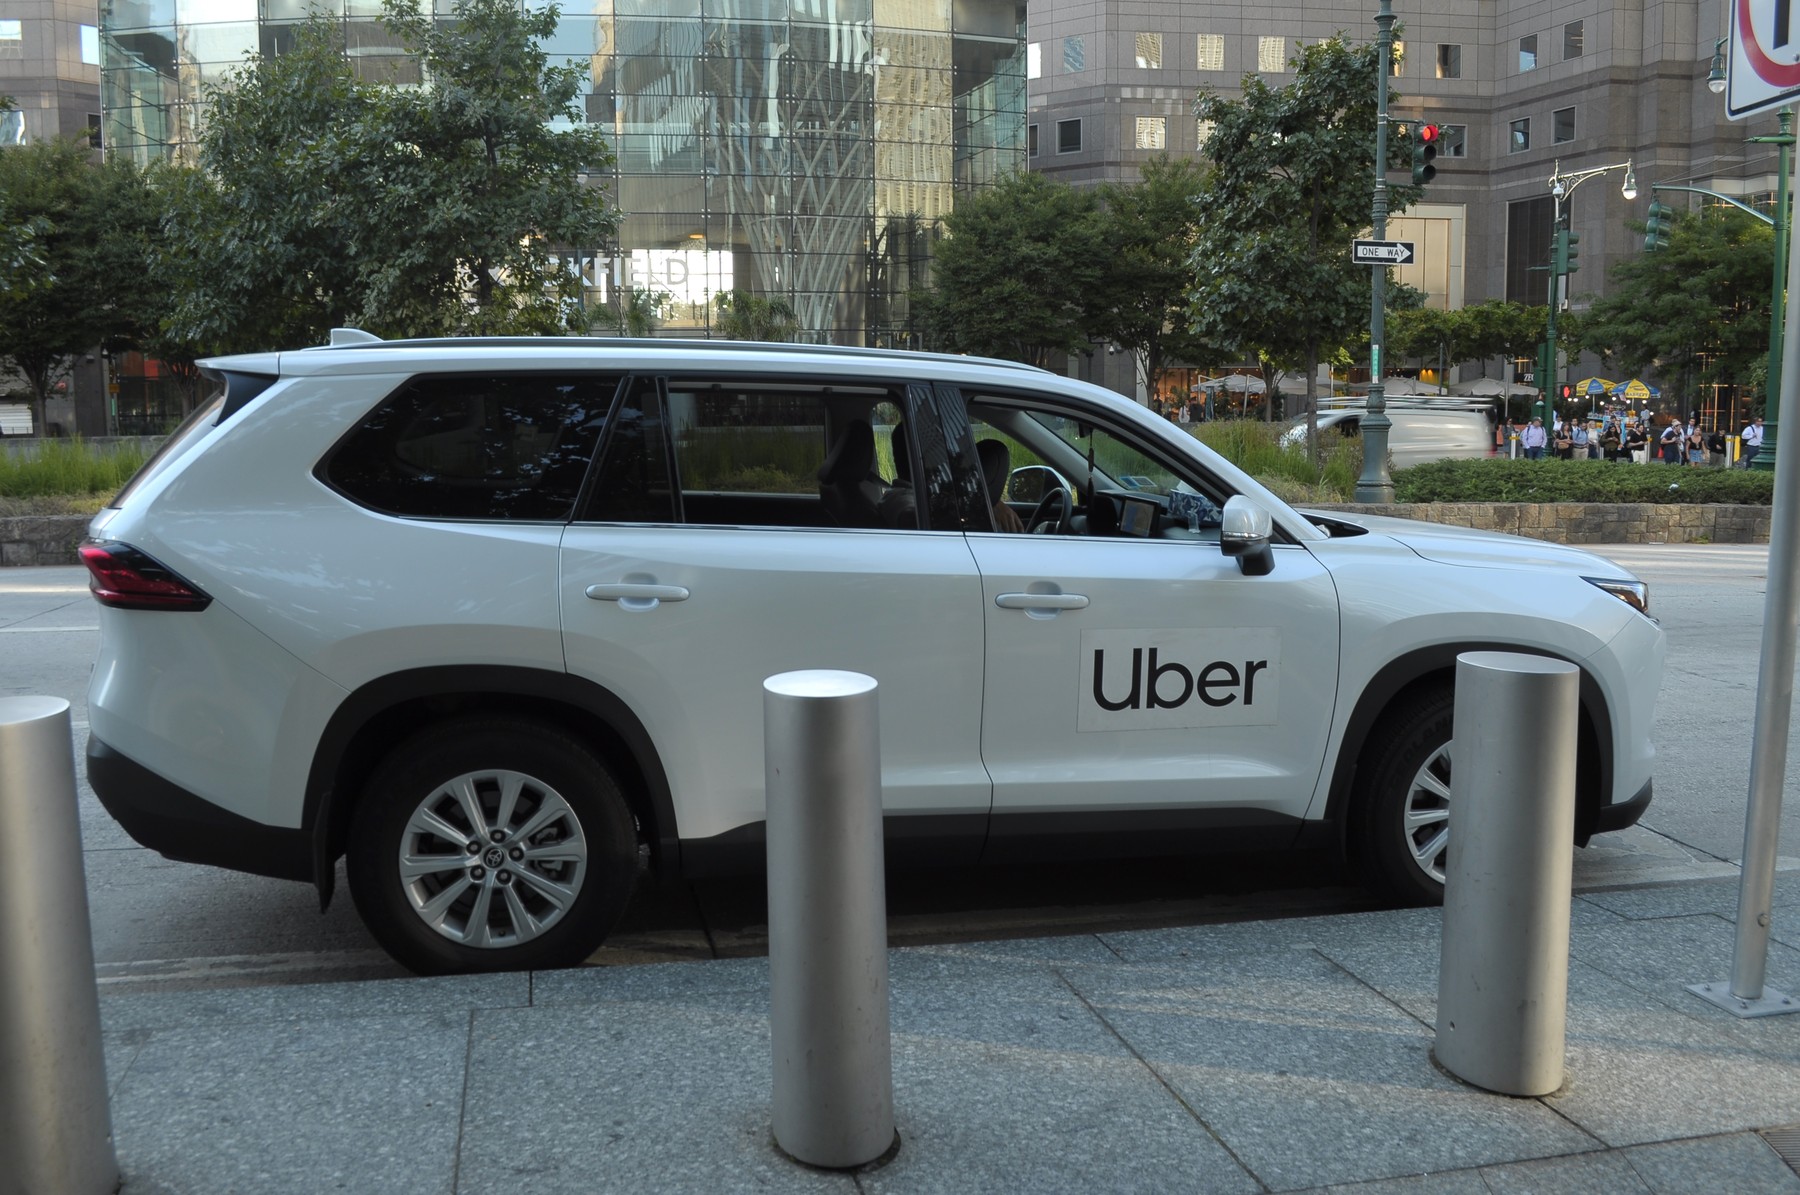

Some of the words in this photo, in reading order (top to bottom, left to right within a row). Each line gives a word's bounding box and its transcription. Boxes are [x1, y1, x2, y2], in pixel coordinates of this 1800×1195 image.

[1362, 247, 1379, 256] ONE
[1387, 248, 1405, 257] WAY
[1093, 647, 1268, 712] Uber
